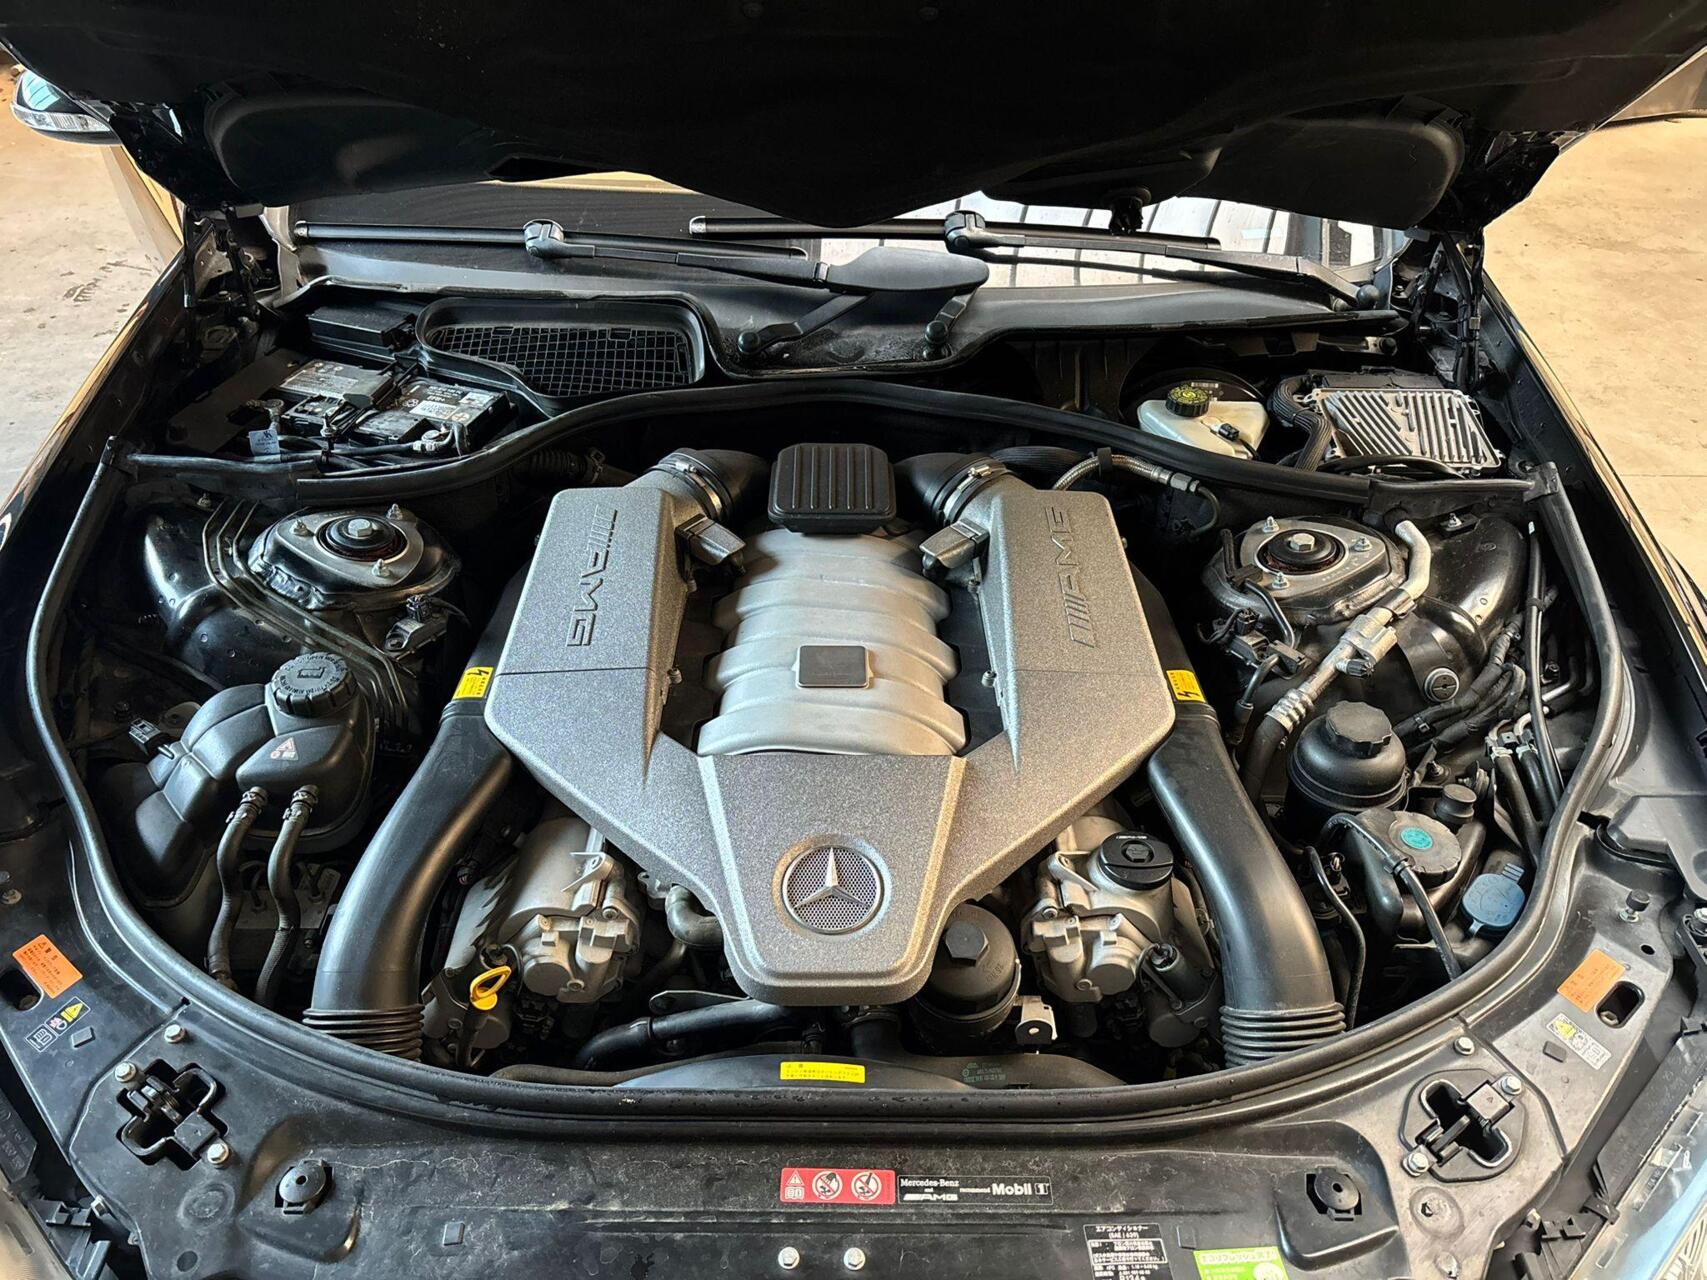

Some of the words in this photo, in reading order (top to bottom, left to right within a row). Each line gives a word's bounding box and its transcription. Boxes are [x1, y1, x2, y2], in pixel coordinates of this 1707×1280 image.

[566, 546, 611, 647] AMG
[900, 1178, 959, 1187] Mercedes-Benz
[991, 1183, 1033, 1195] Mobil
[1034, 1183, 1050, 1195] 1
[917, 1193, 959, 1201] AMG
